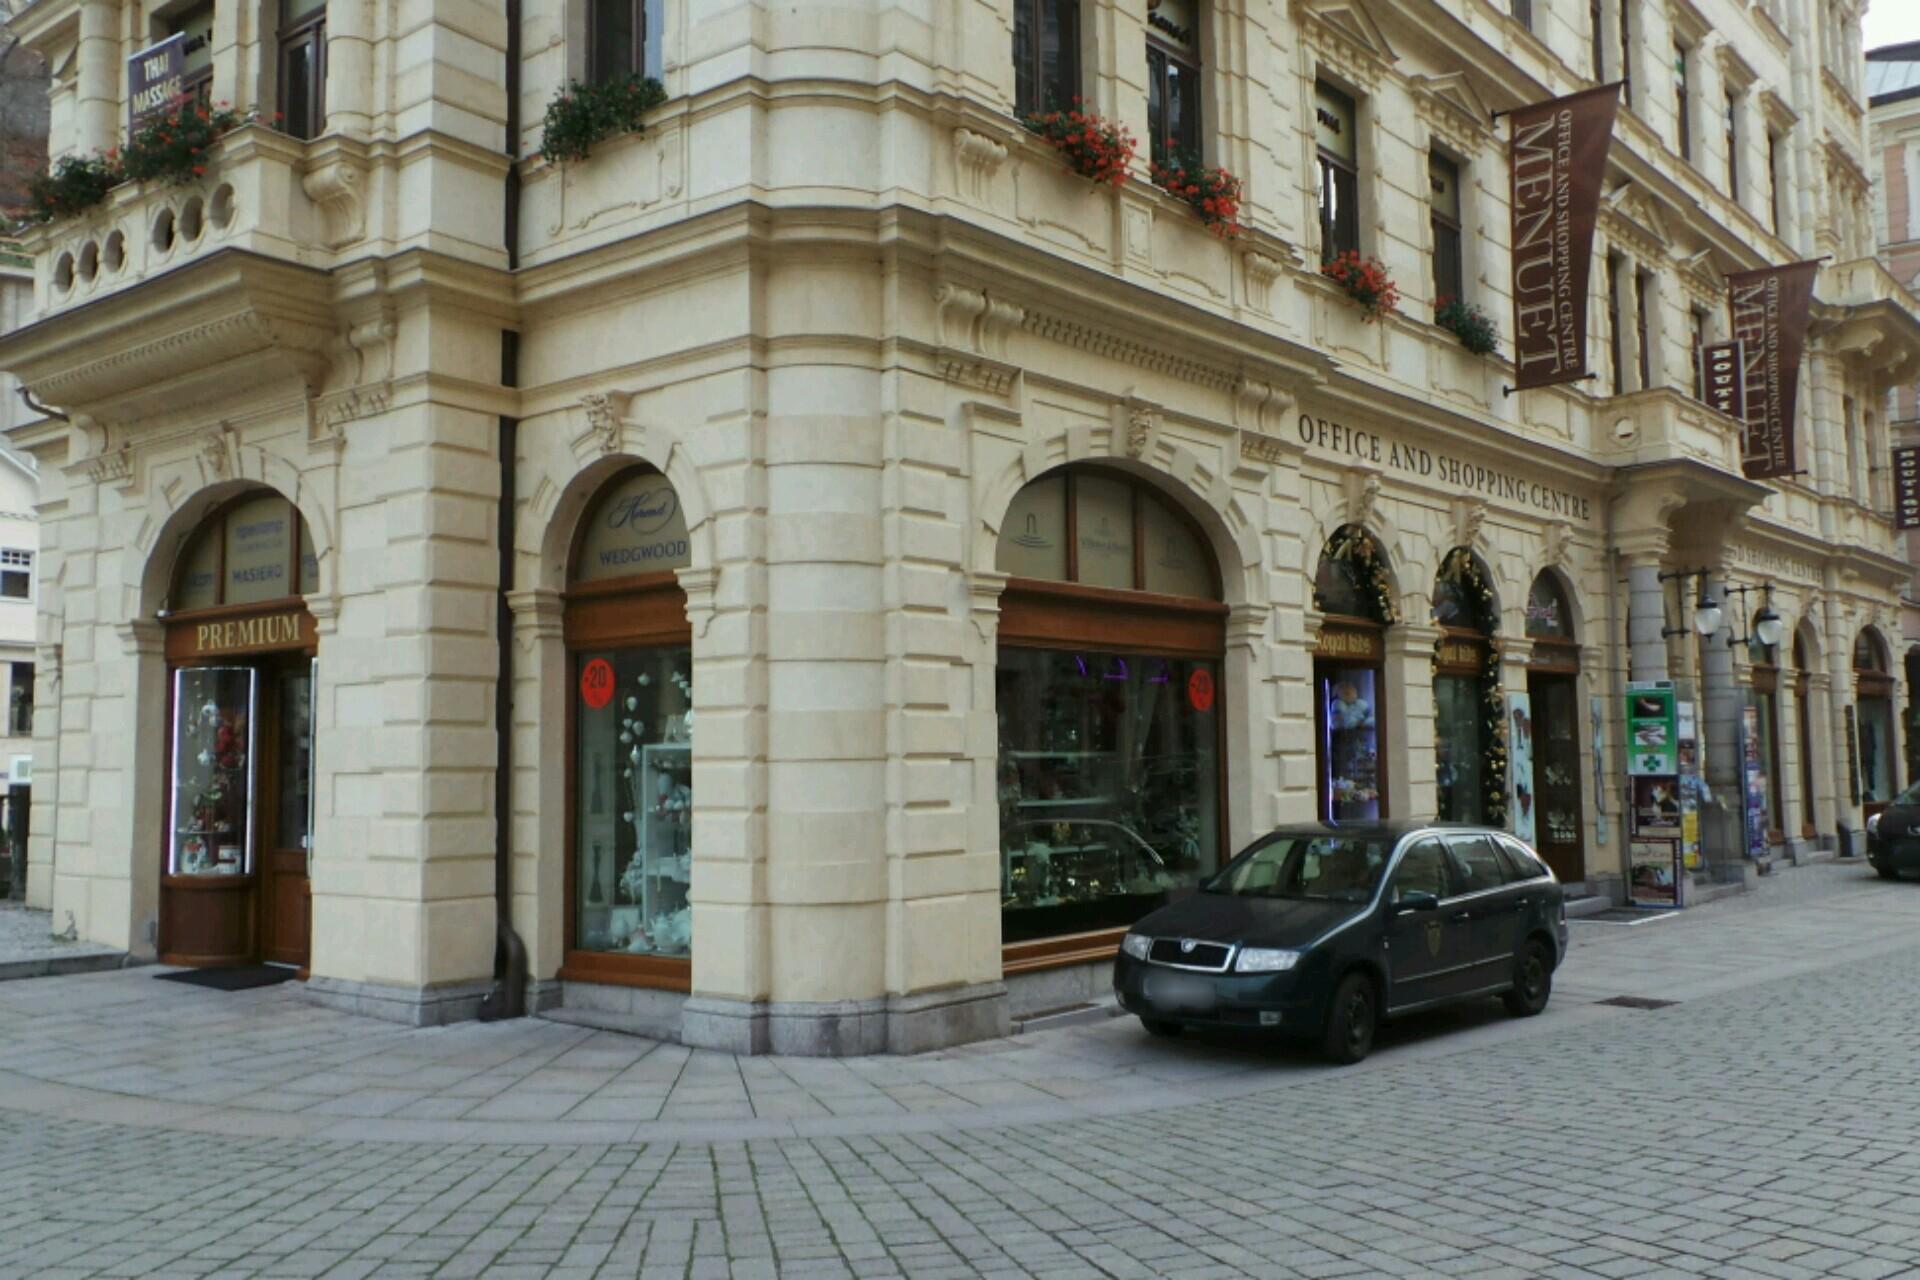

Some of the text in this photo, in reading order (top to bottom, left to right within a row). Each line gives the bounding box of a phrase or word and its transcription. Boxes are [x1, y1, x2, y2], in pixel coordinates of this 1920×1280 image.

[144, 52, 169, 82] THAI
[133, 75, 181, 115] MASSAGE
[1514, 113, 1561, 375] MENUET
[1555, 109, 1578, 370] OFFICE AND SHOPPING CENTRE
[1298, 413, 1590, 521] OFFICE AND SHOPPING CENTRE
[600, 540, 687, 566] WEDGWOOD
[232, 564, 283, 585] MASIERO
[196, 613, 301, 651] PREMIUM
